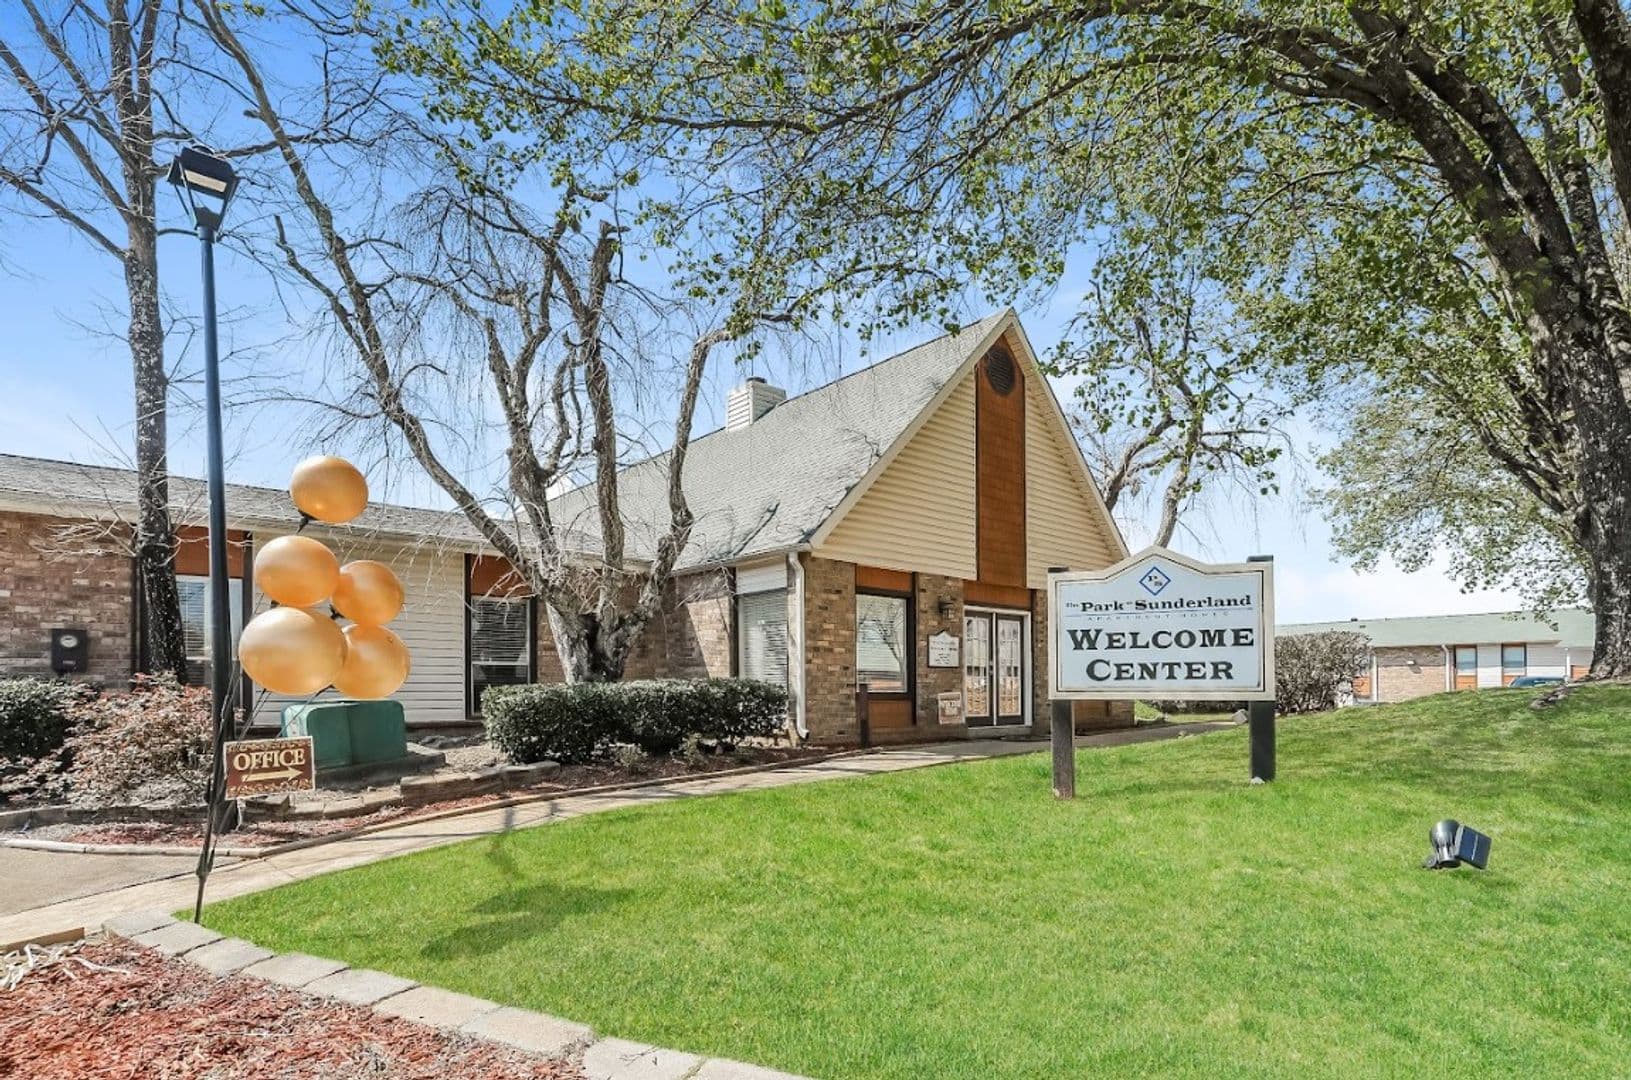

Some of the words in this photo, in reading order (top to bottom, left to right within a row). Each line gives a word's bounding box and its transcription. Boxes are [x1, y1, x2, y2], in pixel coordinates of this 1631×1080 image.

[1081, 600, 1124, 612] Park
[1135, 595, 1252, 611] Sunderland
[1066, 628, 1255, 651] WELCOME
[1086, 658, 1234, 682] CENTER
[233, 748, 306, 771] OFFICE
